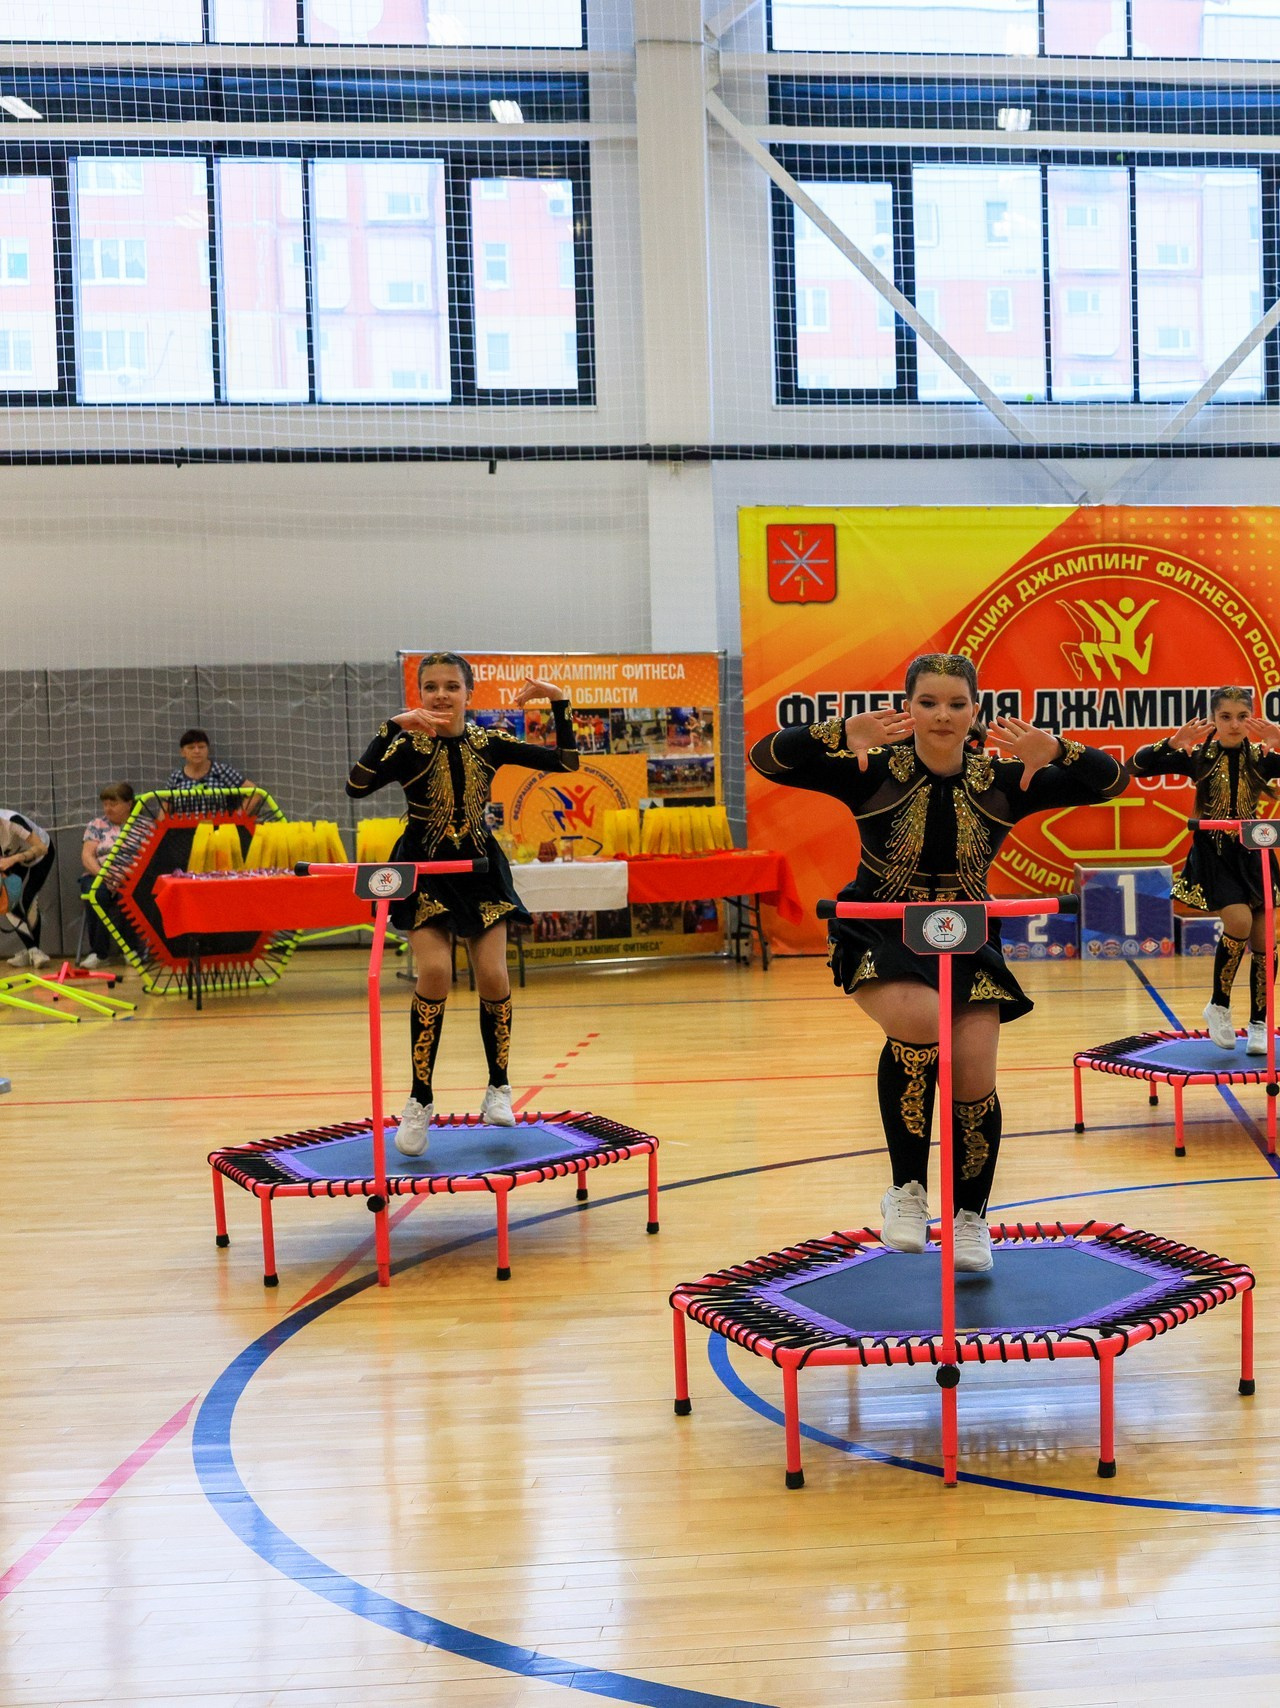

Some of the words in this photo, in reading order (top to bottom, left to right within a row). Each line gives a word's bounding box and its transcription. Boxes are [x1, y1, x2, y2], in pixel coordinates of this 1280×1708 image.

[1015, 553, 1150, 602] ДЖАМПИНГ
[1155, 561, 1248, 630] ФИТНЕСА
[538, 664, 617, 682] ДЖАМПИНГ
[622, 663, 686, 680] ФИТНЕСА
[575, 687, 638, 704] ОБЛАСТИ
[1117, 874, 1137, 936] 1
[1027, 913, 1049, 943] 2
